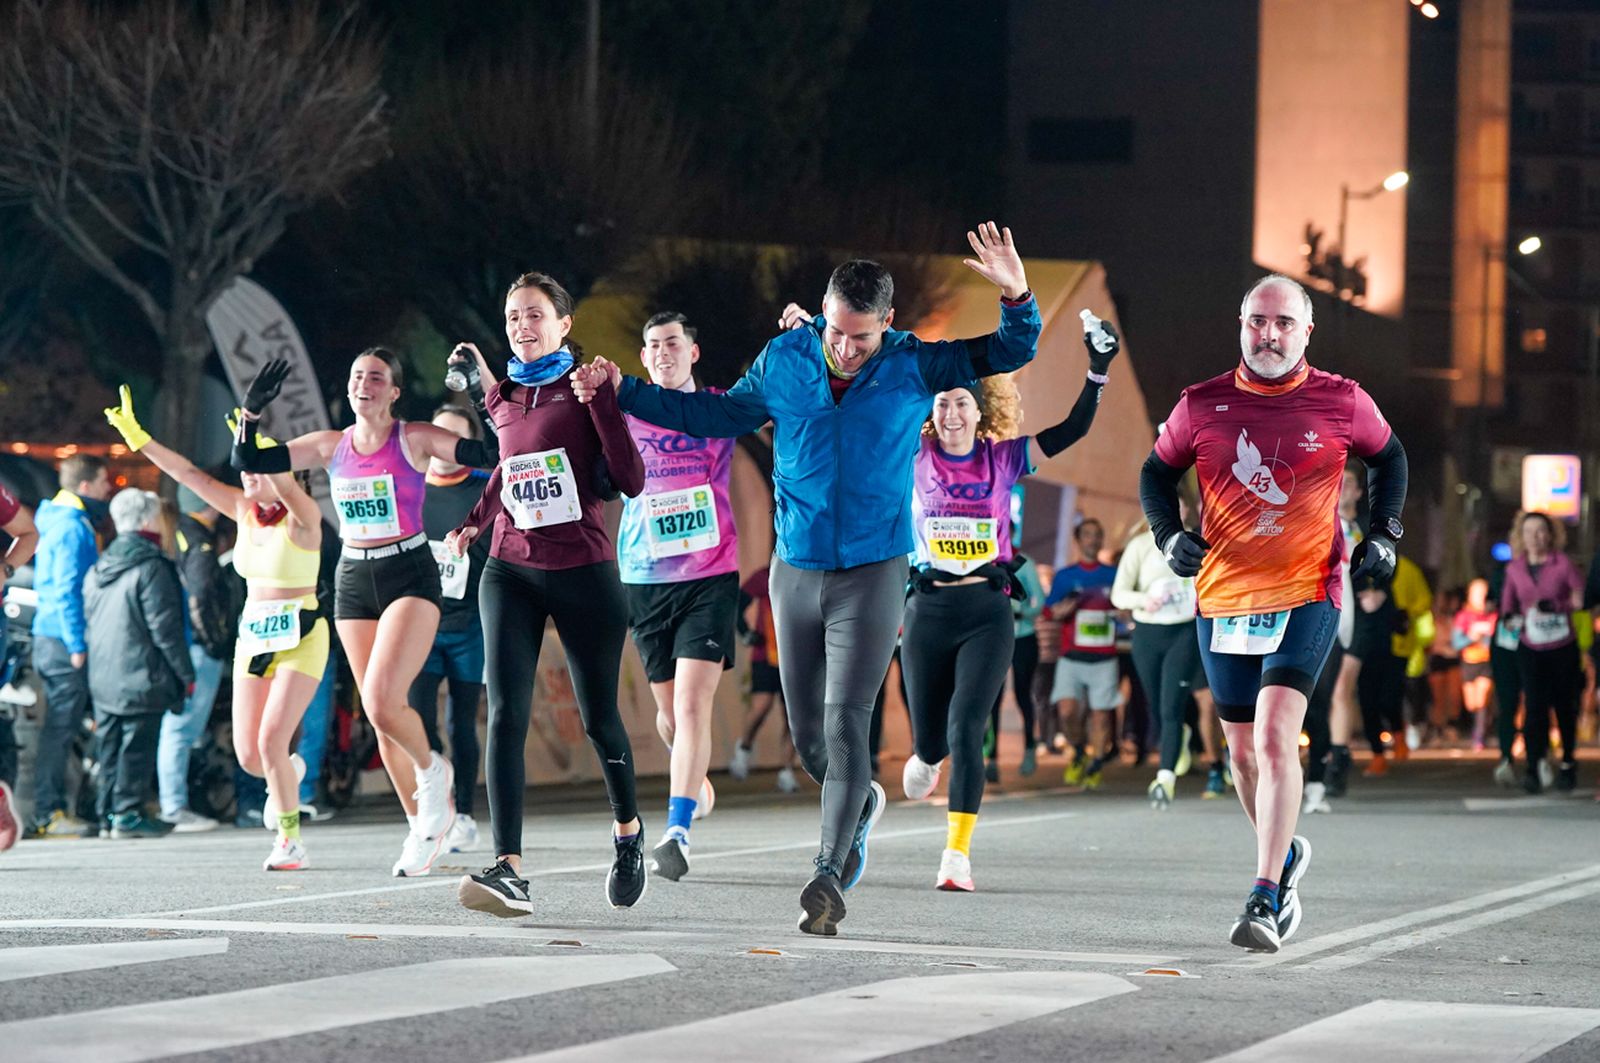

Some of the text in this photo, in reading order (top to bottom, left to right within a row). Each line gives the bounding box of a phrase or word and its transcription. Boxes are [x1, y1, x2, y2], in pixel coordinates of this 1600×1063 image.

[510, 462, 532, 473] NOCHE
[533, 460, 541, 469] DE
[647, 463, 709, 479] ALOBREÑA
[508, 473, 519, 483] AN
[1249, 471, 1272, 494] 43
[340, 498, 389, 519] 3659
[656, 509, 707, 535] 13720
[367, 543, 400, 560] PUMA
[937, 540, 988, 556] 13919
